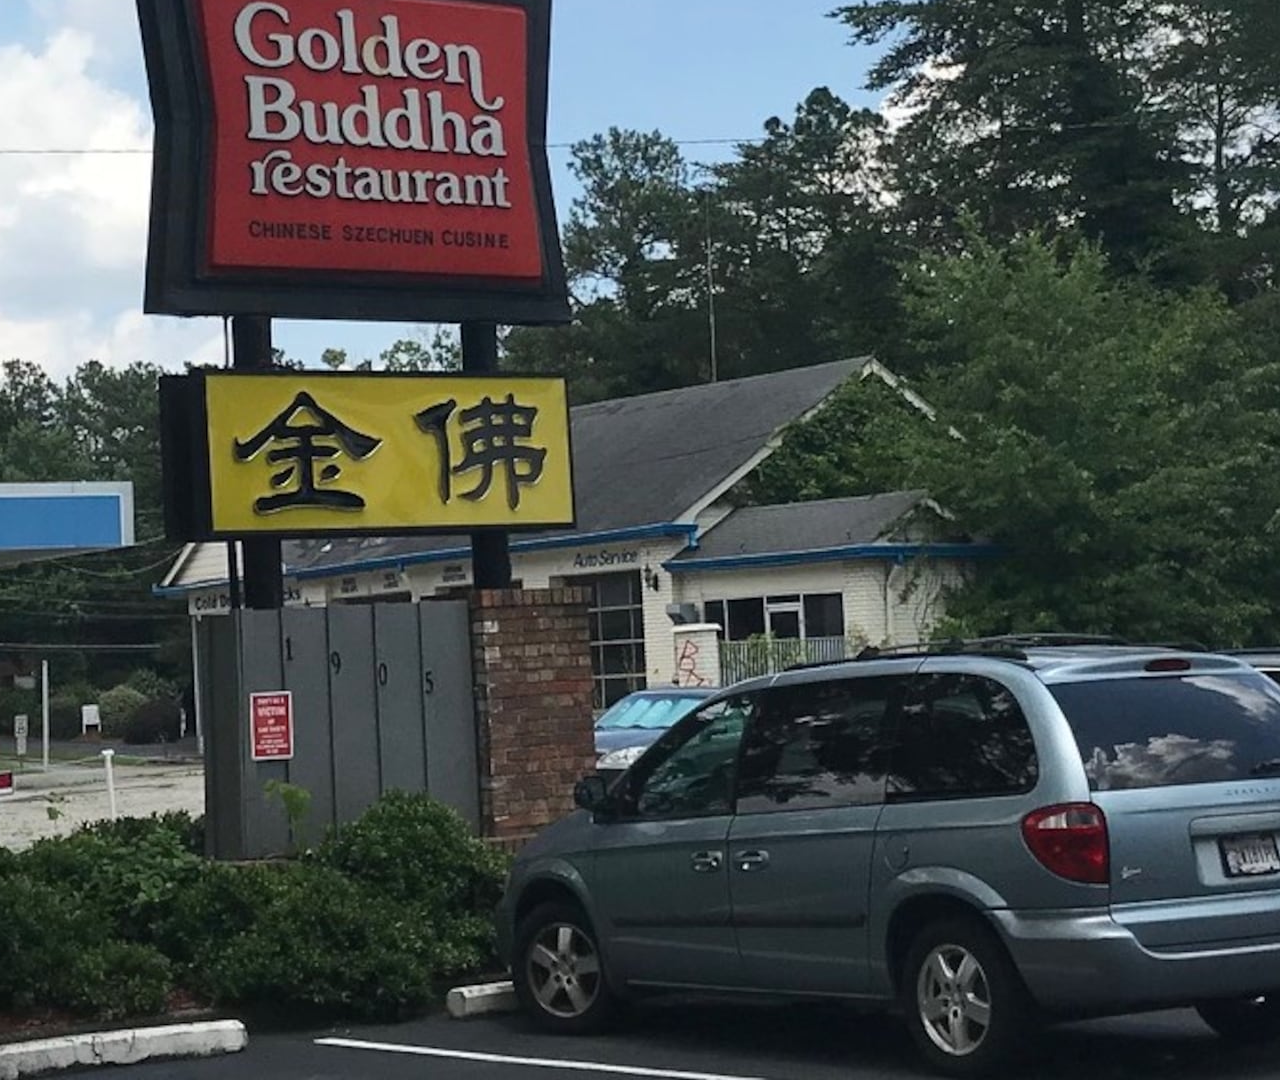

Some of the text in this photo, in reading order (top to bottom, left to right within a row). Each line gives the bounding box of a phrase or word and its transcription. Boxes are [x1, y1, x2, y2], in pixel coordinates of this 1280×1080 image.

[233, 0, 505, 112] Golden
[243, 74, 508, 157] Buddha
[250, 149, 513, 209] restaurant
[248, 220, 510, 249] CHINESE SZECHUEN CUSINE
[232, 391, 548, 512] 金佛
[573, 548, 639, 568] Auto Service
[194, 594, 217, 611] Cold
